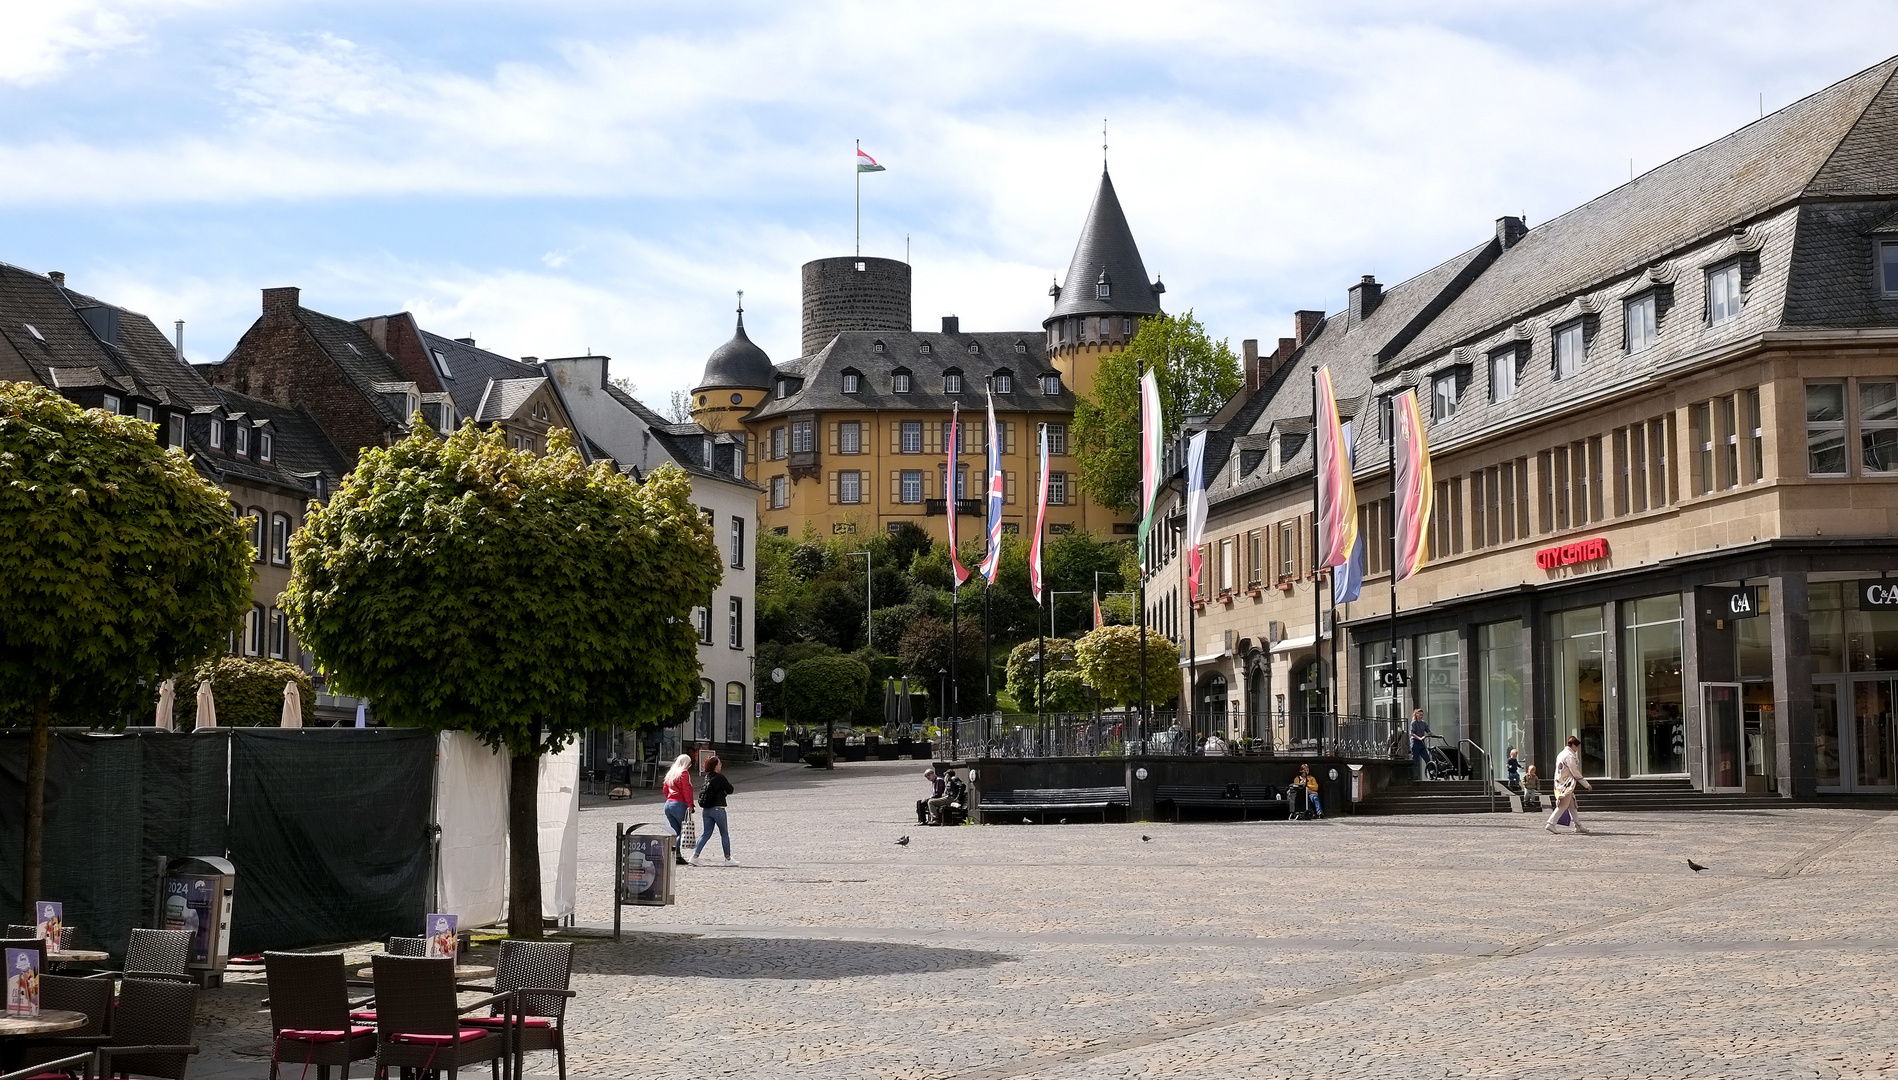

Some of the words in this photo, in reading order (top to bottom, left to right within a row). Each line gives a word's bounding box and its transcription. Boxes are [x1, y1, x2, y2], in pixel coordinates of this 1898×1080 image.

[1536, 547, 1560, 569] CITY
[1561, 538, 1607, 565] CENTER
[1730, 592, 1751, 613] C&A
[1866, 584, 1898, 605] C&A
[1384, 672, 1404, 684] CA
